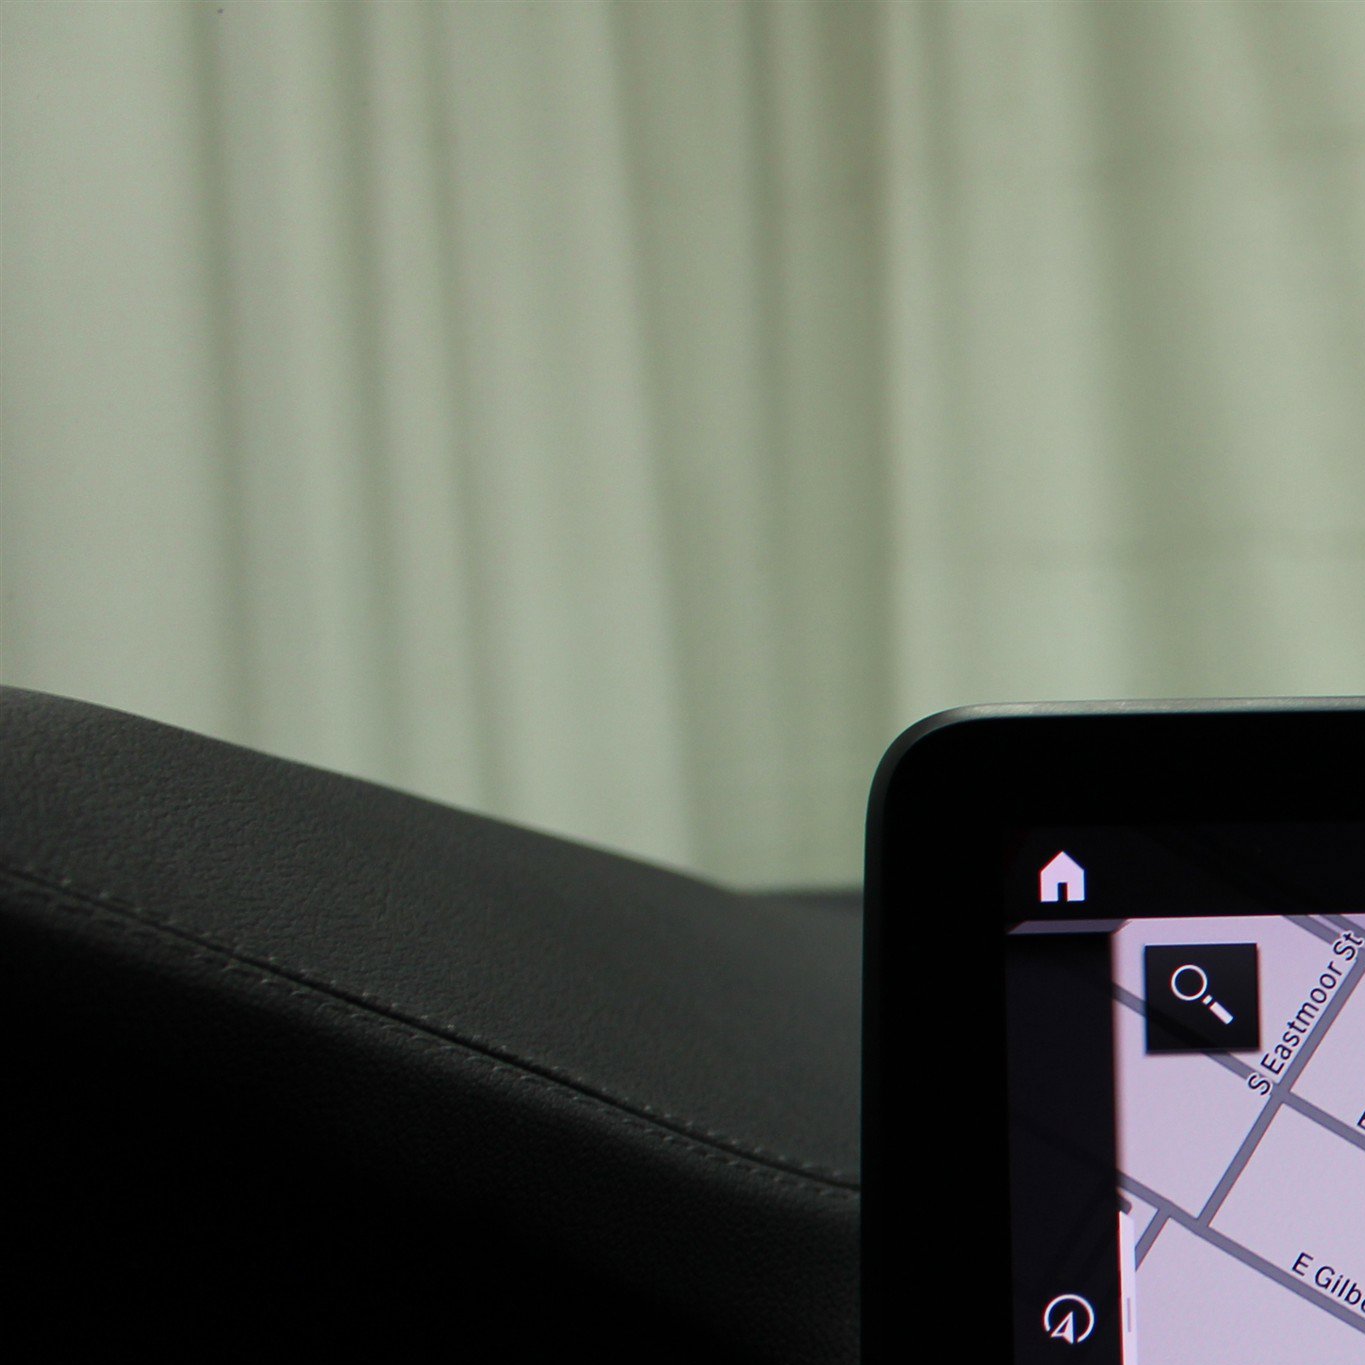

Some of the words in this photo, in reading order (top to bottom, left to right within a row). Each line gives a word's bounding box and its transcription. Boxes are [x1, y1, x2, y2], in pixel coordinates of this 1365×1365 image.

[1248, 1073, 1273, 1096] S
[1262, 963, 1342, 1075] Eastmoor
[1333, 931, 1364, 964] St
[1291, 1252, 1314, 1276] E
